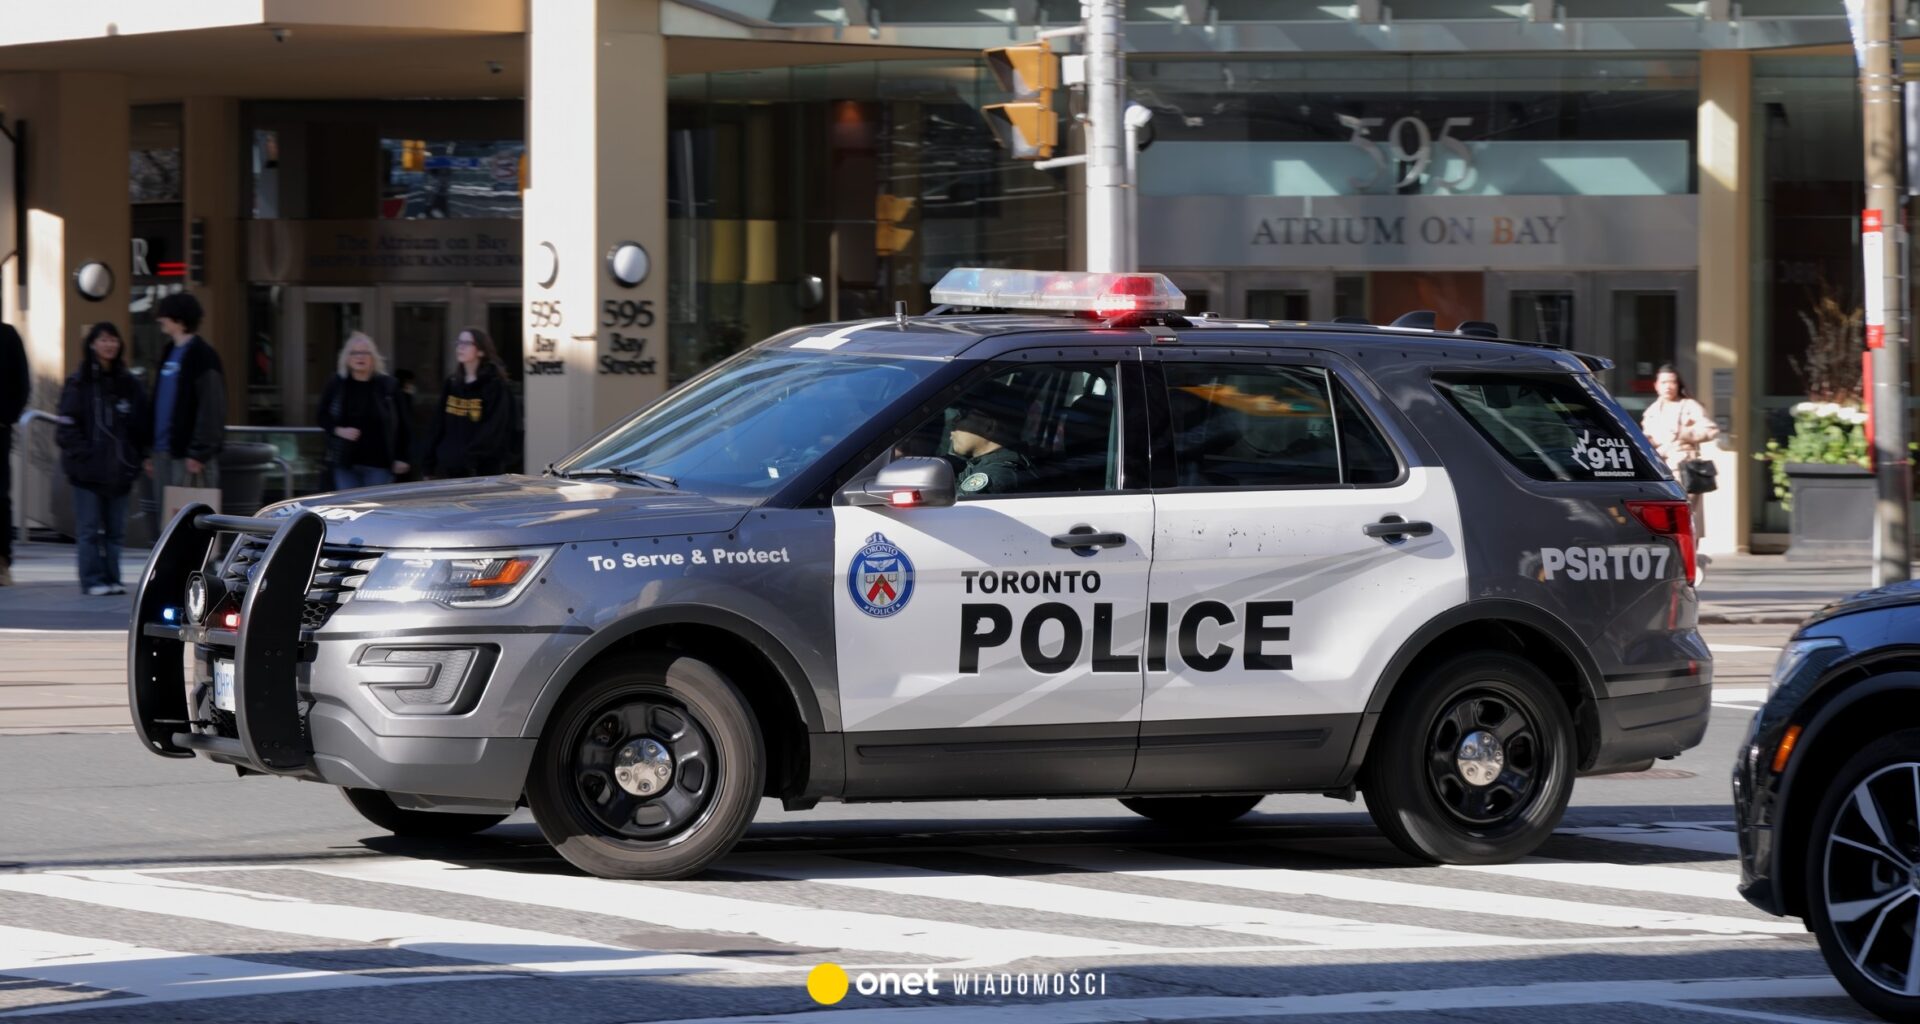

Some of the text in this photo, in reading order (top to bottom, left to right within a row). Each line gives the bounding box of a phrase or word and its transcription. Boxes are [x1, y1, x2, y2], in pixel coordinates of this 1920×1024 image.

[1343, 117, 1477, 192] 595
[377, 233, 440, 250] Atrium
[445, 238, 469, 250] on
[476, 233, 509, 253] Bay
[1250, 217, 1564, 245] ATRIUM ON BAY
[530, 300, 562, 327] 595
[602, 300, 655, 328] 595
[610, 332, 647, 359] Bay
[598, 355, 657, 375] Street
[1596, 438, 1630, 448] CALL
[587, 547, 791, 572] To Serve & Protect
[861, 544, 898, 557] TORONTO
[1540, 546, 1671, 581] PSRT07
[960, 571, 1101, 594] TORONTO
[869, 605, 896, 616] POLICE
[958, 600, 1294, 674] POLICE
